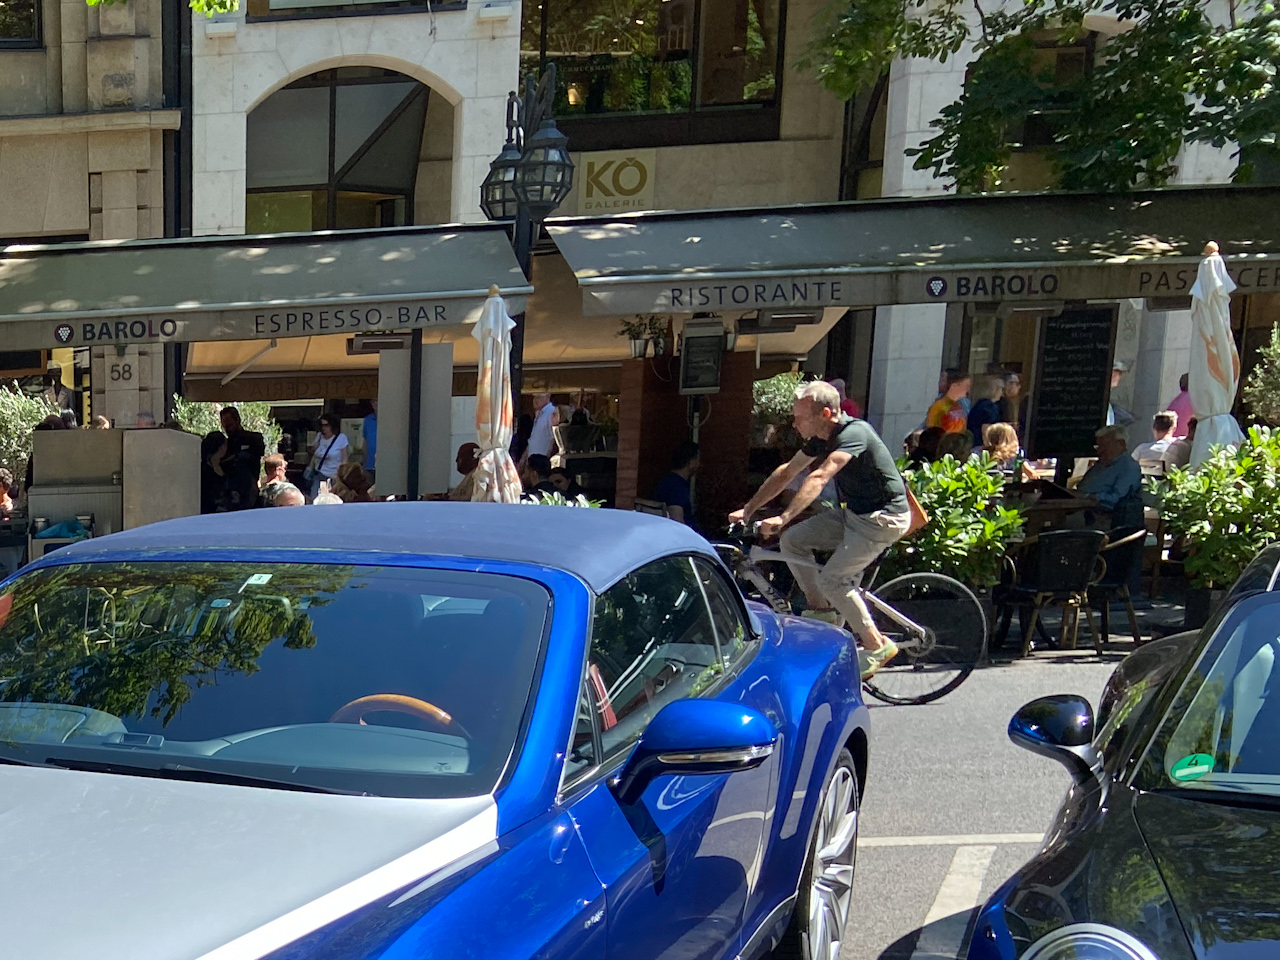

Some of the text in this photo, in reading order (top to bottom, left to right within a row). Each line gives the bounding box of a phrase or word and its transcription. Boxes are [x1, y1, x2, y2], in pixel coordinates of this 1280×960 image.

[585, 199, 645, 209] GALERIE
[671, 281, 841, 308] RISTORANTE
[956, 274, 1058, 297] BAROLO
[82, 318, 177, 341] BAROLO
[255, 305, 447, 334] ESPRESSO-BAR
[110, 364, 132, 381] 58
[1187, 755, 1199, 766] 4
